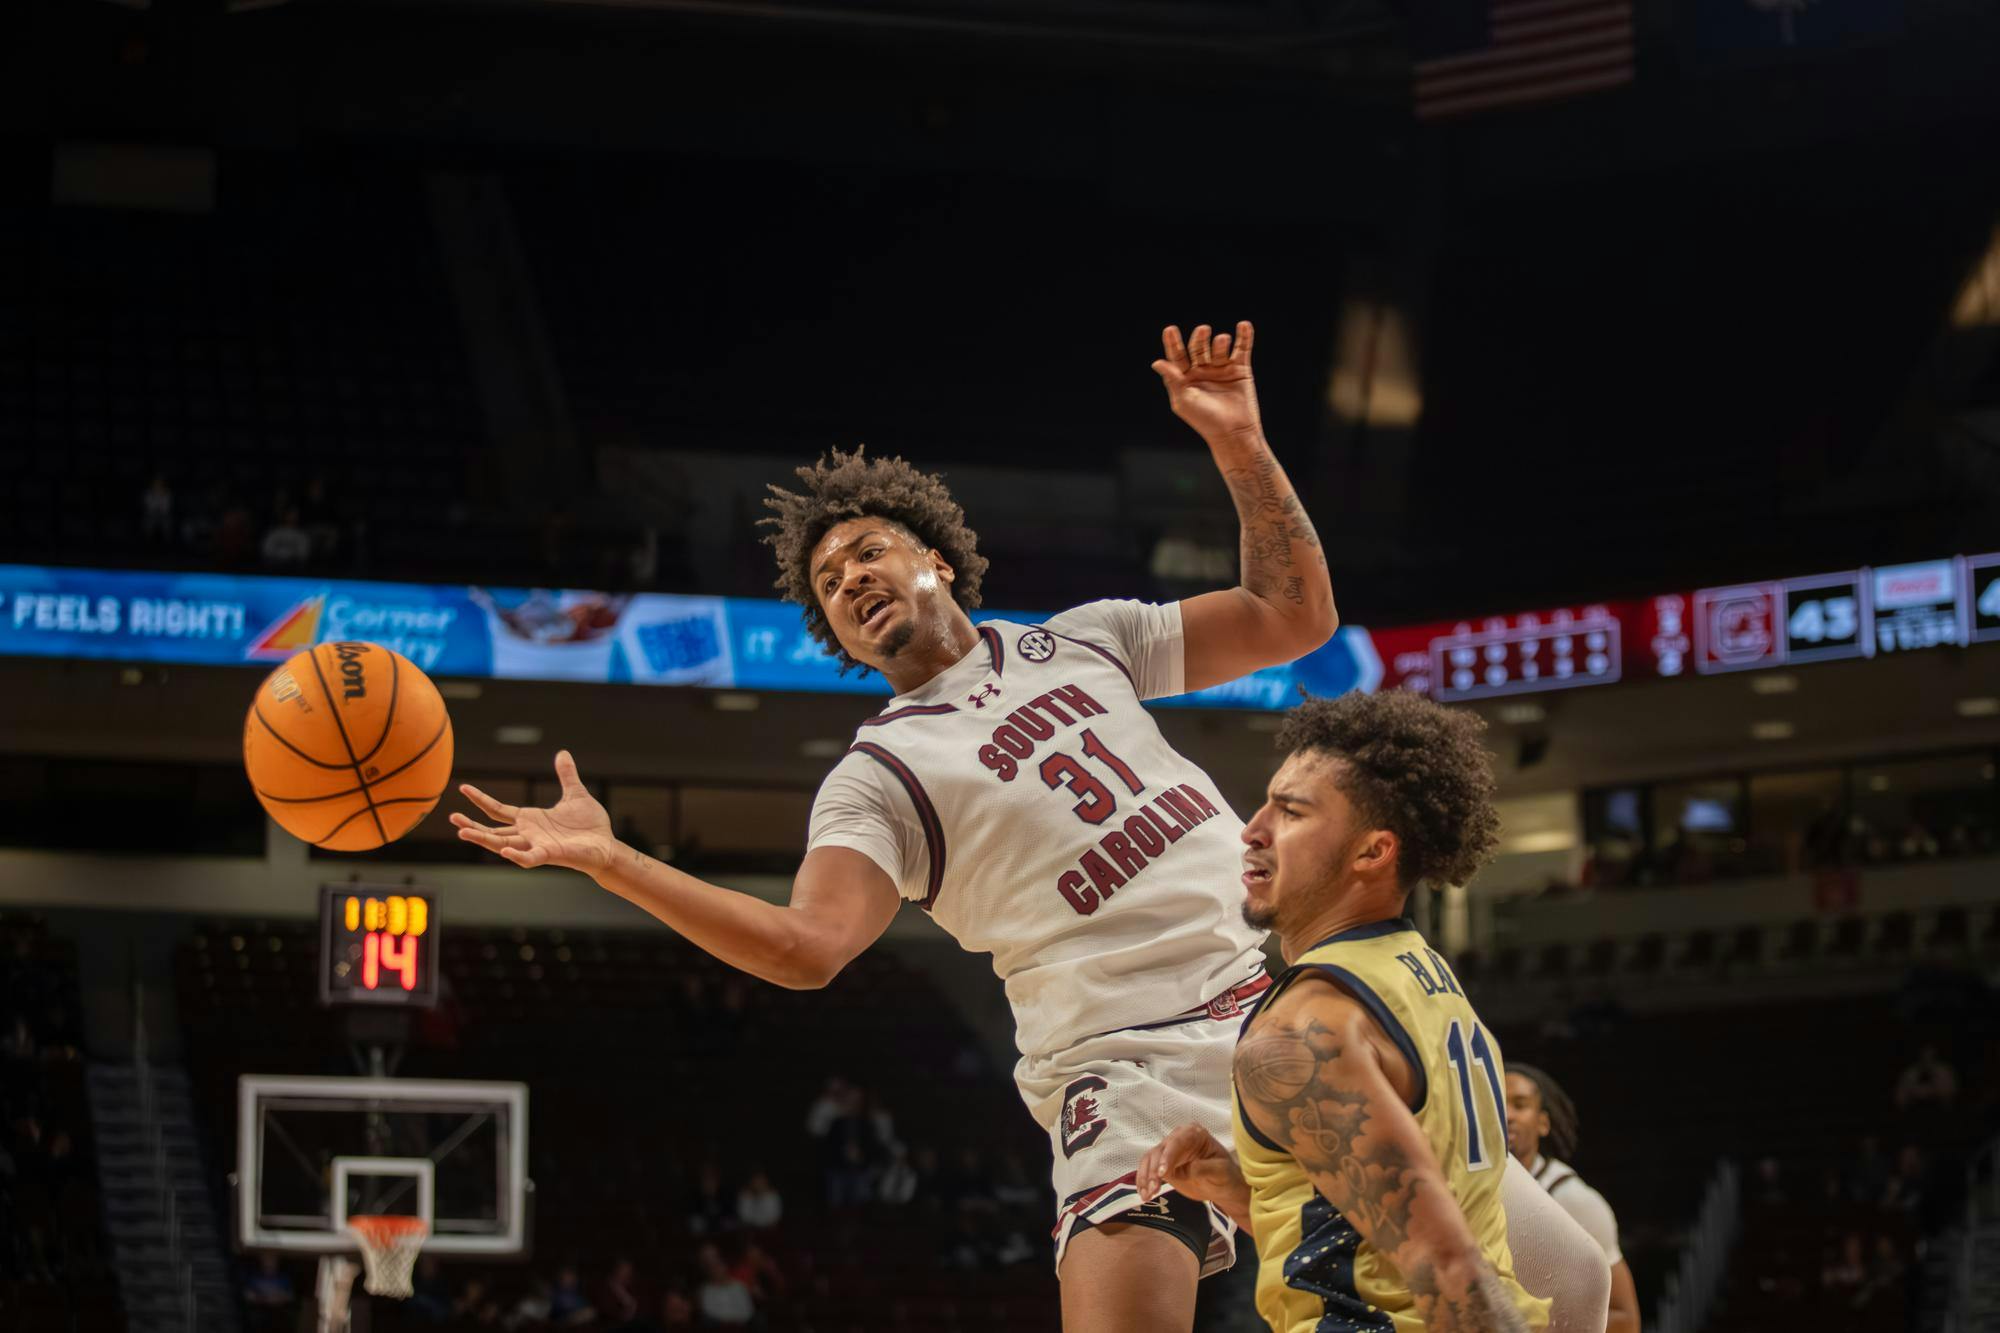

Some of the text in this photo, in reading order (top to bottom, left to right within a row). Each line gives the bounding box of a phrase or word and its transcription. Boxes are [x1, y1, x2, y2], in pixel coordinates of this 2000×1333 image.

[13, 594, 246, 640] FEELS RIGHT!
[978, 683, 1109, 783] SOUTH
[1038, 727, 1147, 826] 31
[1057, 783, 1220, 916] CAROLINA
[361, 931, 418, 991] 14
[1394, 947, 1464, 998] BLA
[1446, 1017, 1509, 1173] 11
